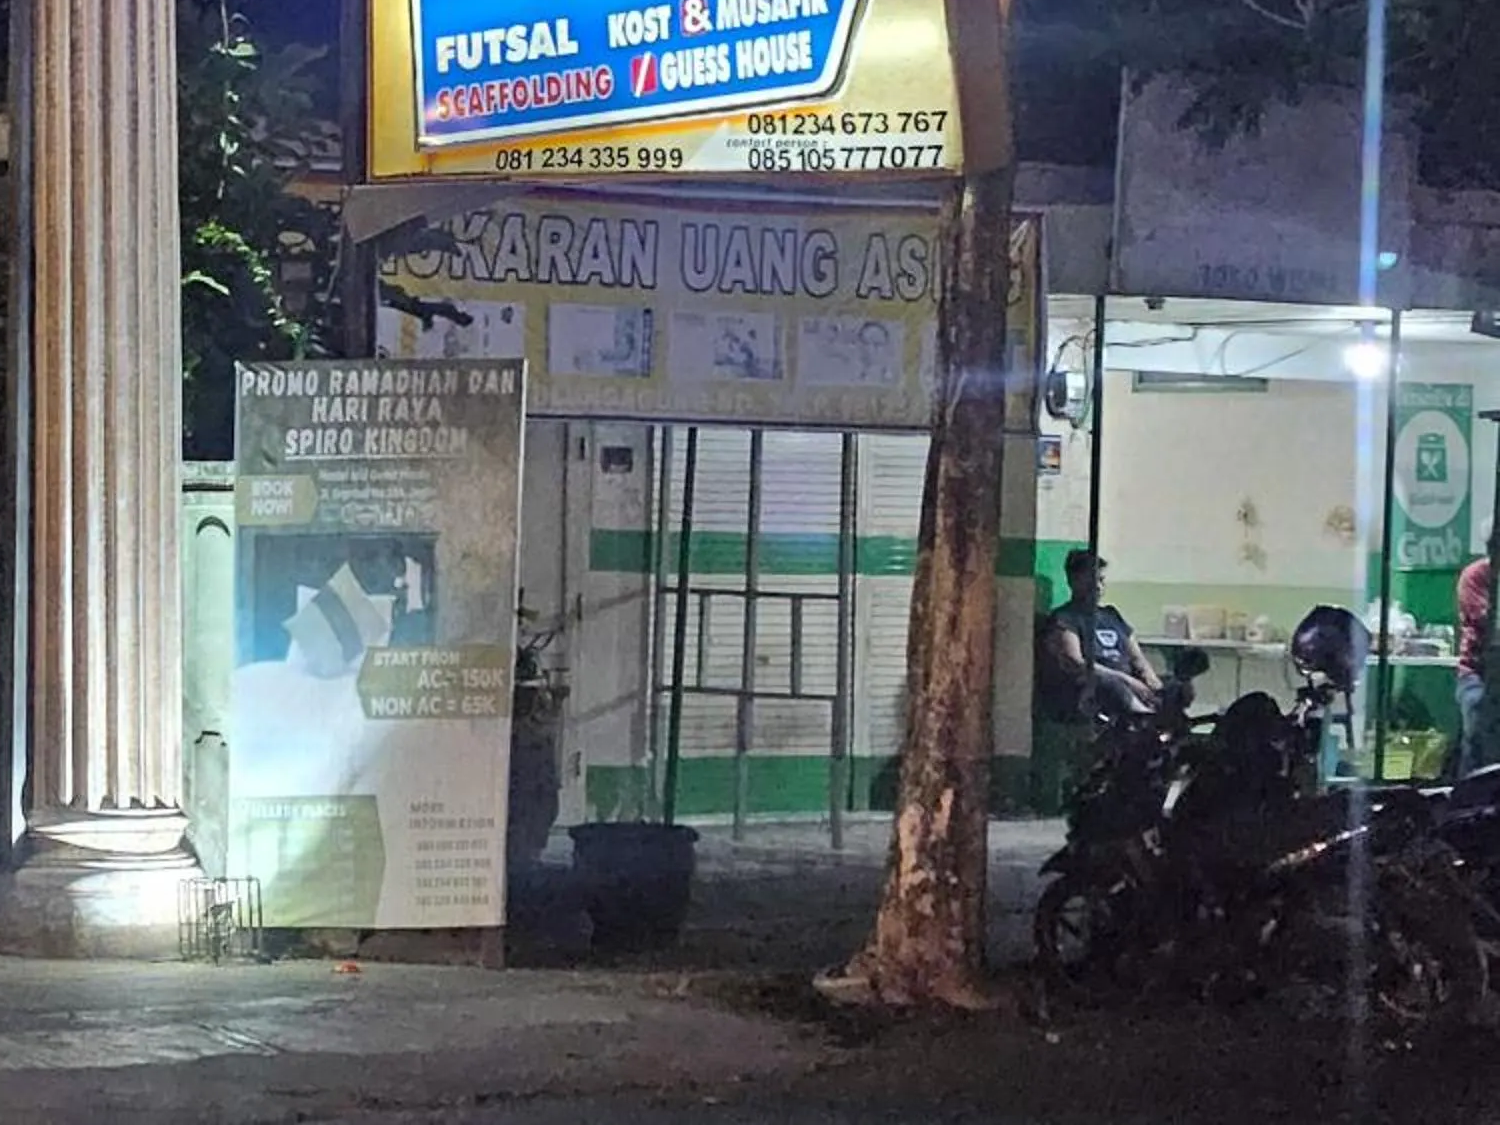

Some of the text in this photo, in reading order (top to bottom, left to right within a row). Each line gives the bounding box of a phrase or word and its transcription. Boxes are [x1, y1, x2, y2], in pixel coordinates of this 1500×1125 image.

[607, 5, 671, 48] KOST
[436, 18, 579, 73] FUTSAL
[660, 42, 731, 91] GUESS
[735, 30, 813, 79] HOUSE
[436, 63, 614, 123] SCAFFOLDING
[897, 110, 948, 133] 767
[495, 149, 533, 170] 081
[637, 147, 683, 168] 999
[680, 223, 838, 298] UANG
[241, 369, 515, 396] PROMO RAMADHAN DAN
[312, 397, 442, 423] HARI RAYA
[285, 428, 468, 454] SPIRO KINGDOM
[373, 650, 419, 666] START
[371, 696, 412, 716] NON
[417, 697, 442, 716] AC
